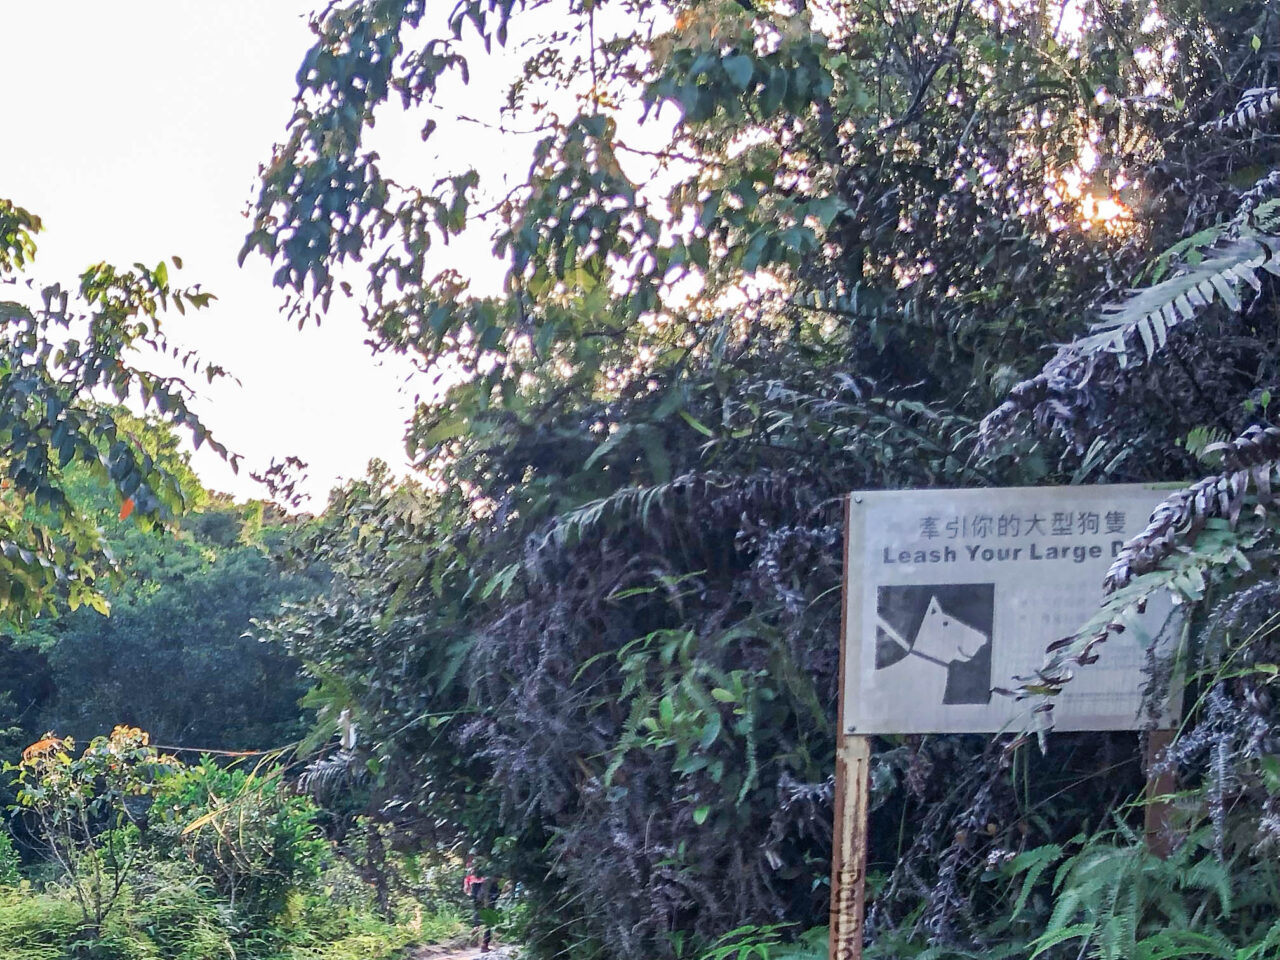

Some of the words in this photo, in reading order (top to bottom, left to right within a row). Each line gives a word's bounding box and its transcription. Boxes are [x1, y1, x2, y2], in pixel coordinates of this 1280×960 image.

[920, 511, 1127, 540] 牽引你的大型狗隻
[882, 545, 956, 565] Leash
[965, 544, 1022, 562] Your
[1029, 543, 1102, 563] Large
